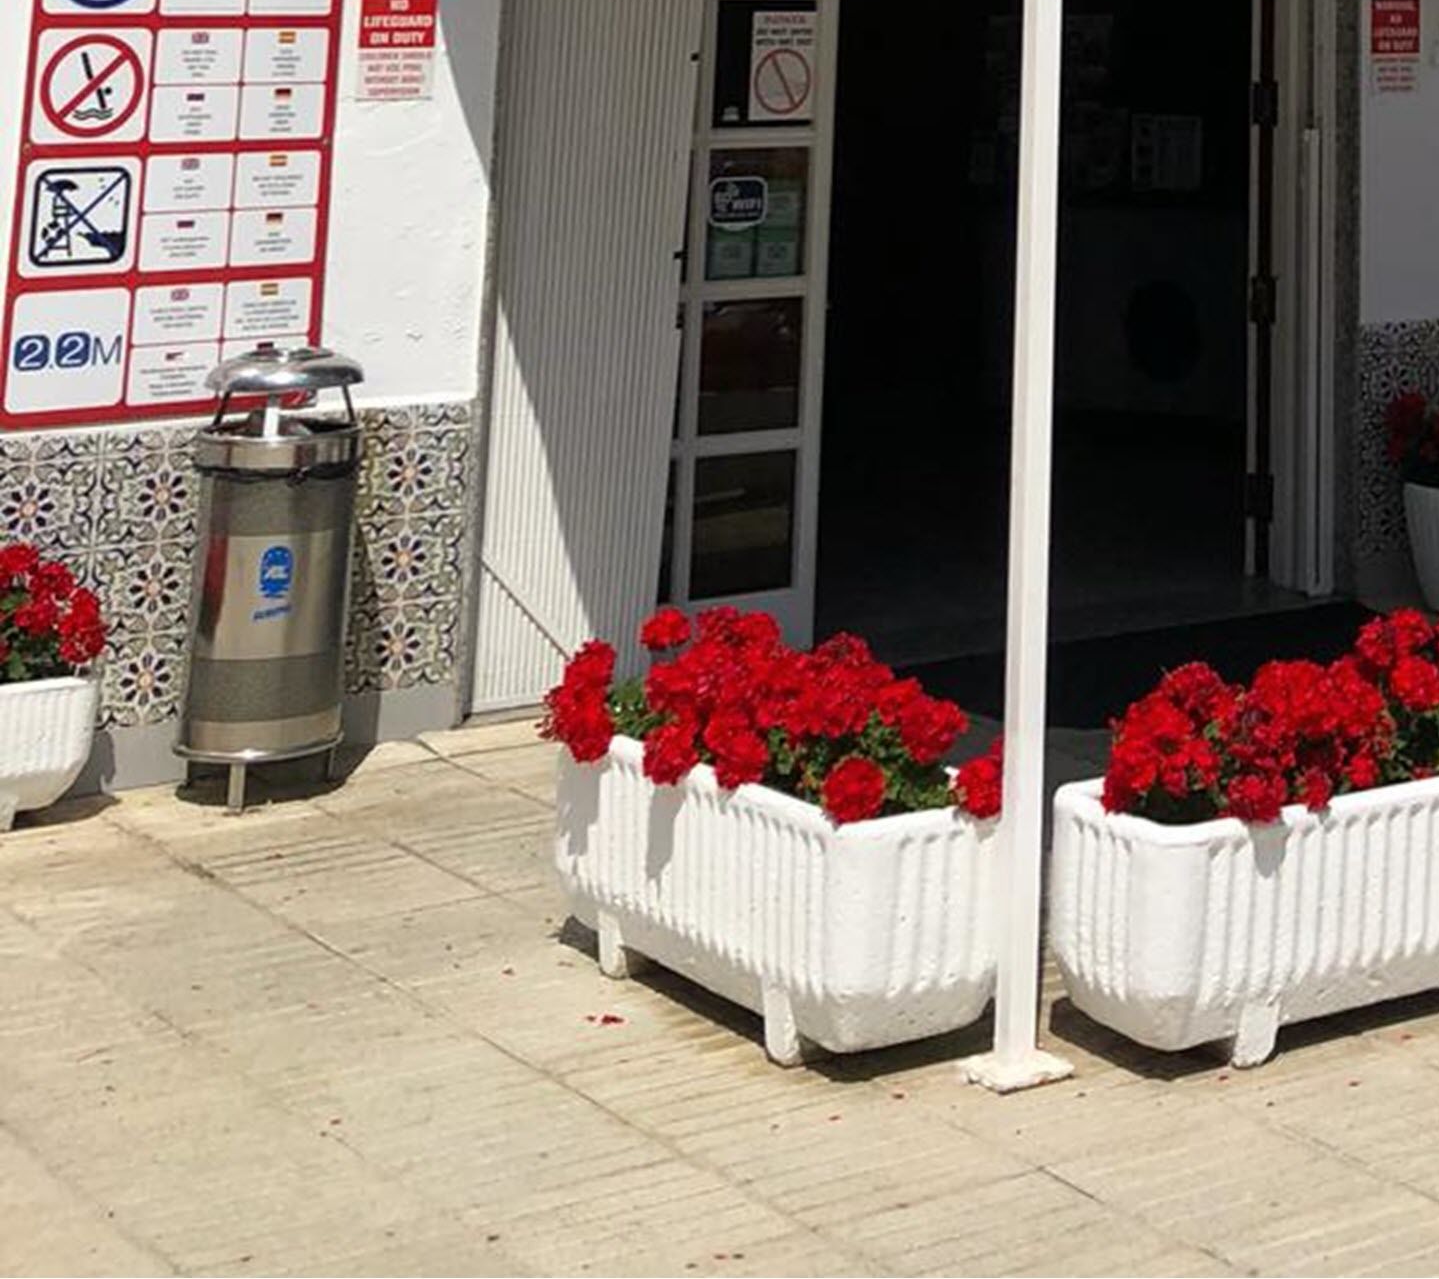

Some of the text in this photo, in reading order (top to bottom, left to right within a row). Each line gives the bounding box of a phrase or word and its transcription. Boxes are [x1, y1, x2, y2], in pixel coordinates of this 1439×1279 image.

[363, 14, 434, 28] LIFEGUARD
[369, 31, 426, 45] ON DUTY
